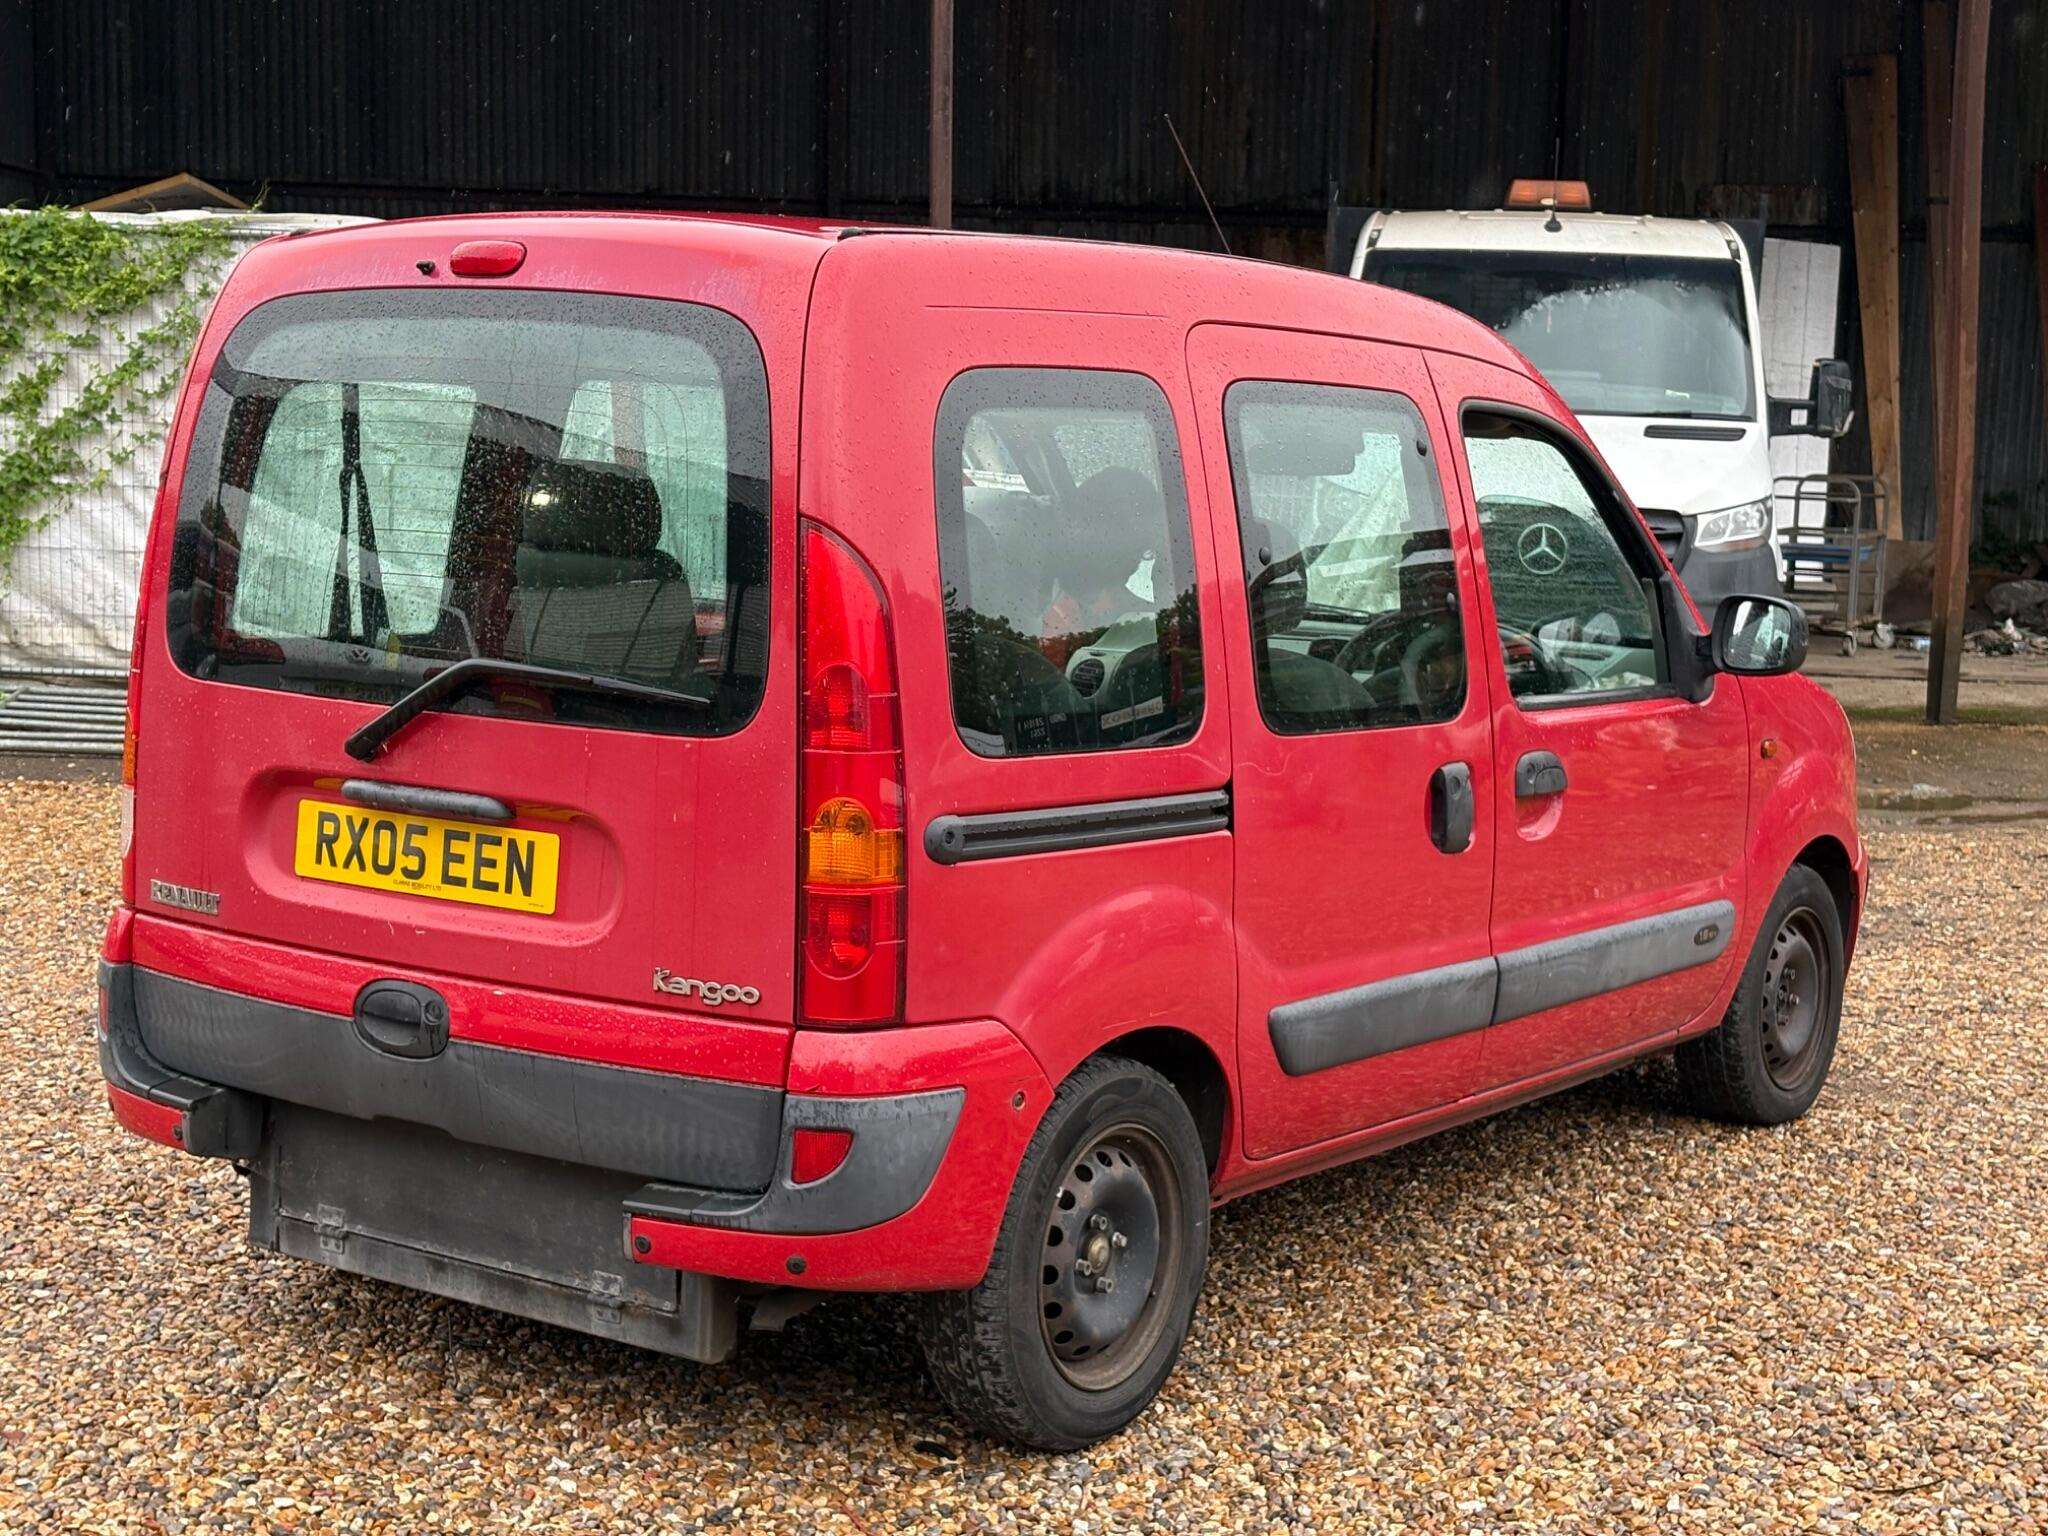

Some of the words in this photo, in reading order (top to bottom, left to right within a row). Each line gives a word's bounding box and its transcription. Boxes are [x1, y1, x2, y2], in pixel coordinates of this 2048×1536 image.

[315, 811, 428, 880] RX05
[442, 829, 535, 897] EEN
[151, 879, 220, 915] RENAULT
[653, 967, 760, 1006] Kangoo
